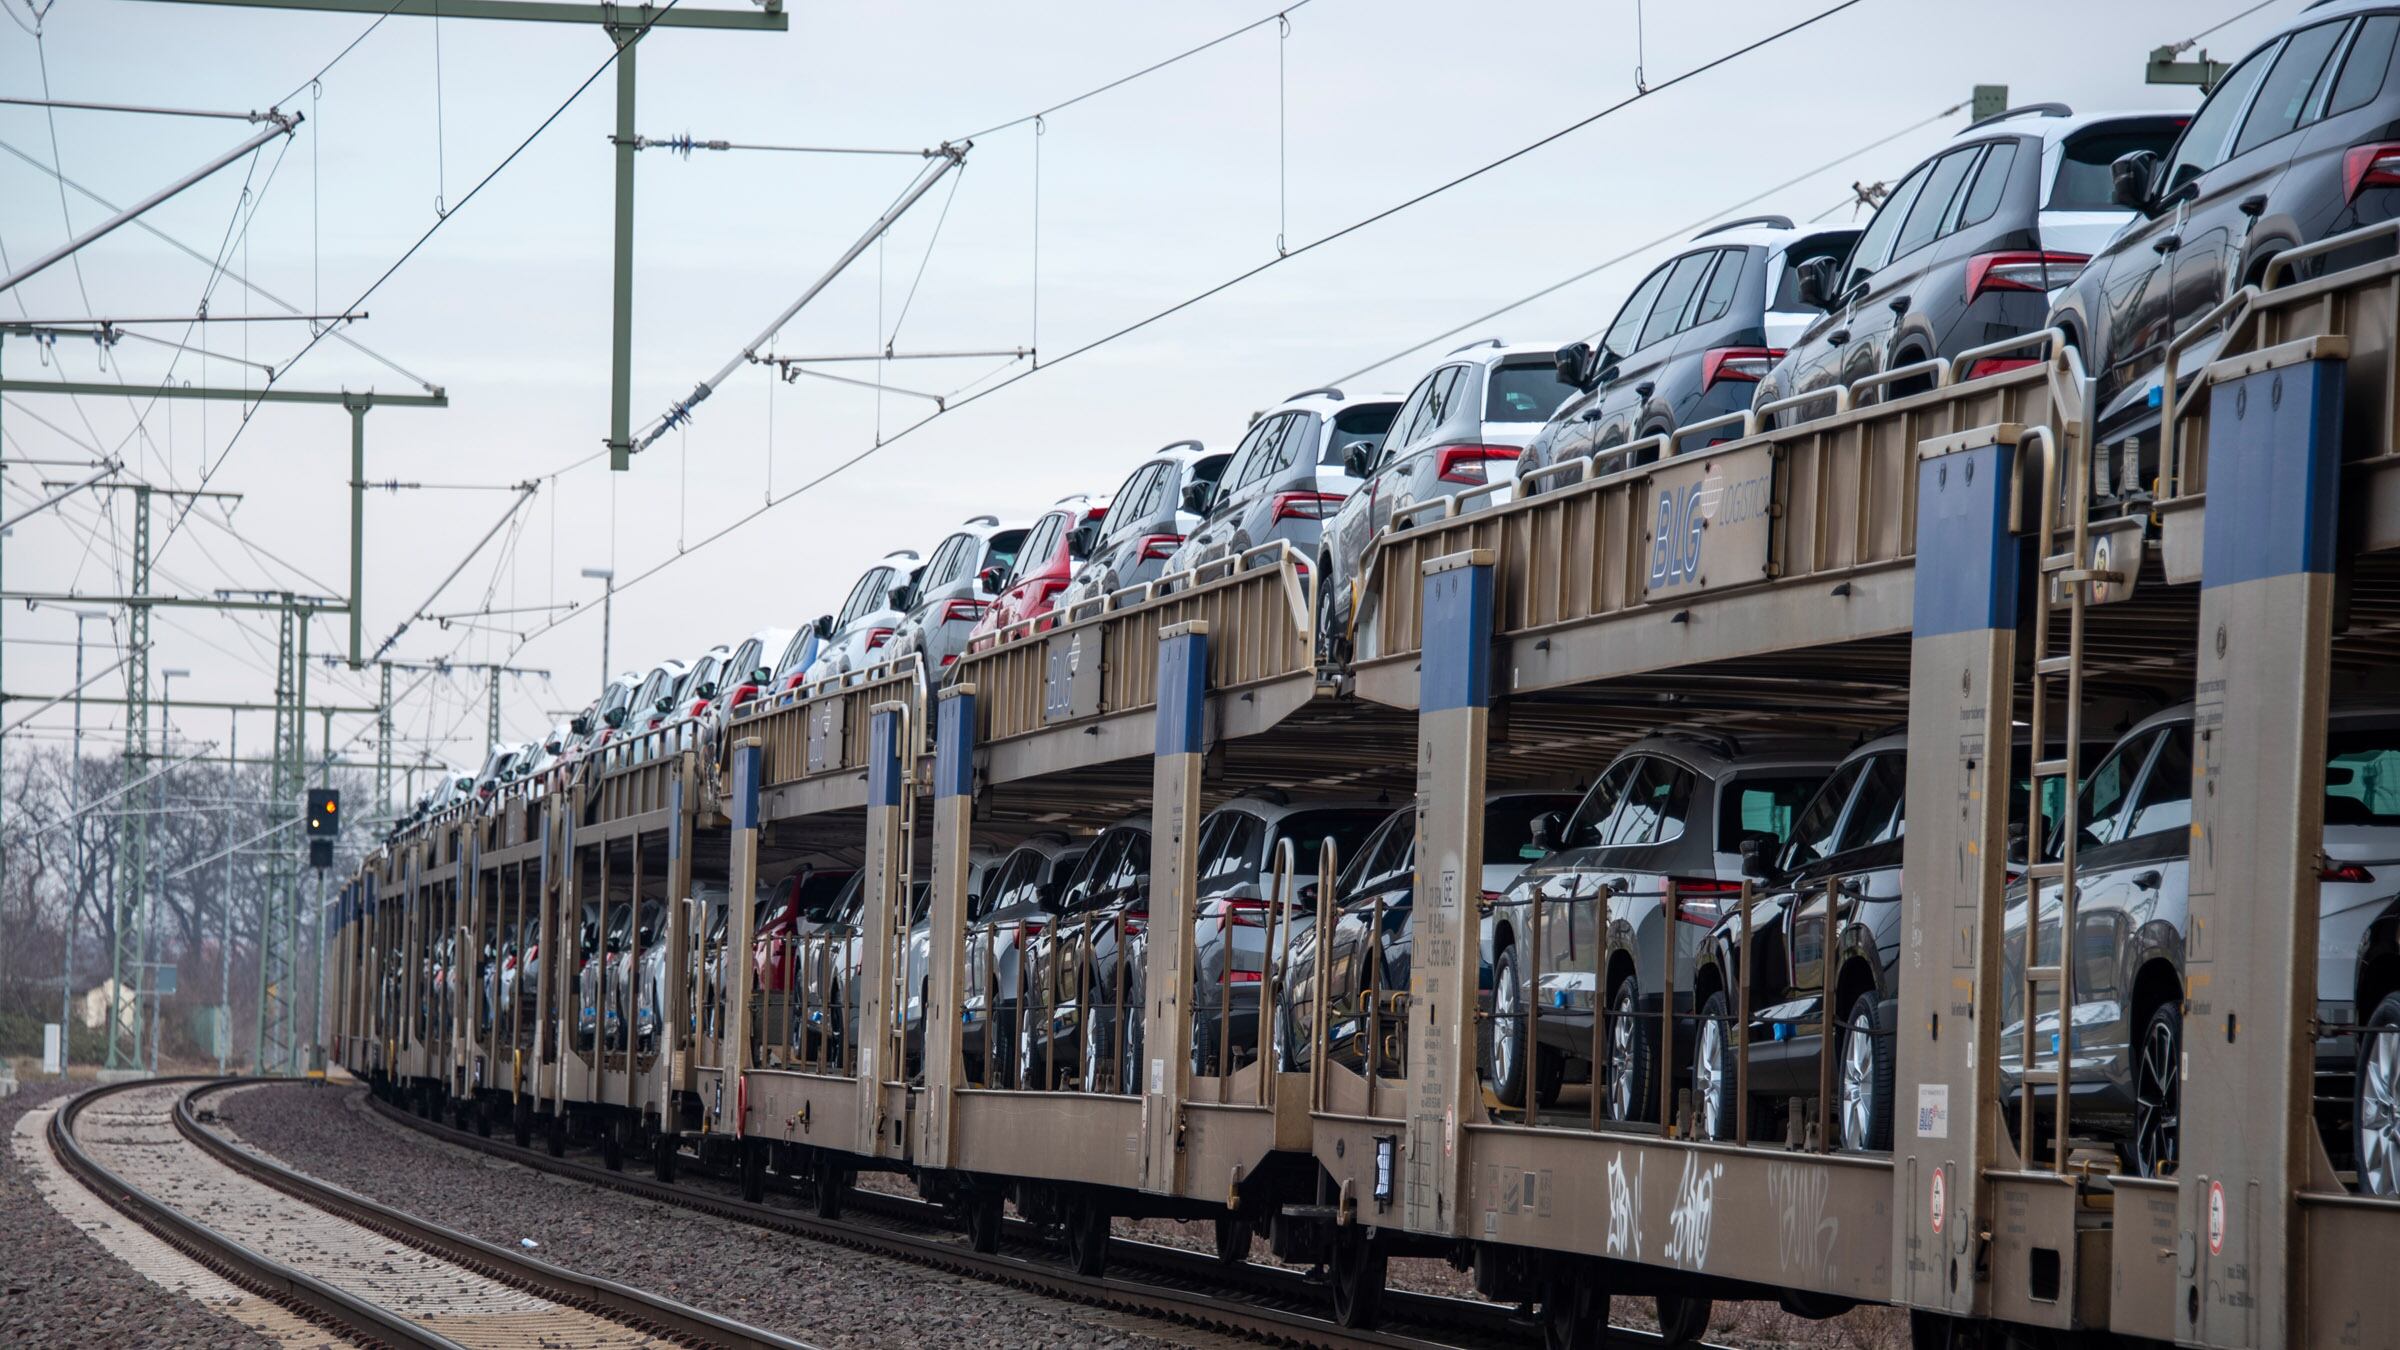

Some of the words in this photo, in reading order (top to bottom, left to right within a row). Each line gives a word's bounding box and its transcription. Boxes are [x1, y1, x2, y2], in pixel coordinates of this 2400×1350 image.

[1649, 480, 1703, 589] BLG
[1718, 475, 1769, 527] LOGISTICS
[1046, 646, 1074, 717] BLG
